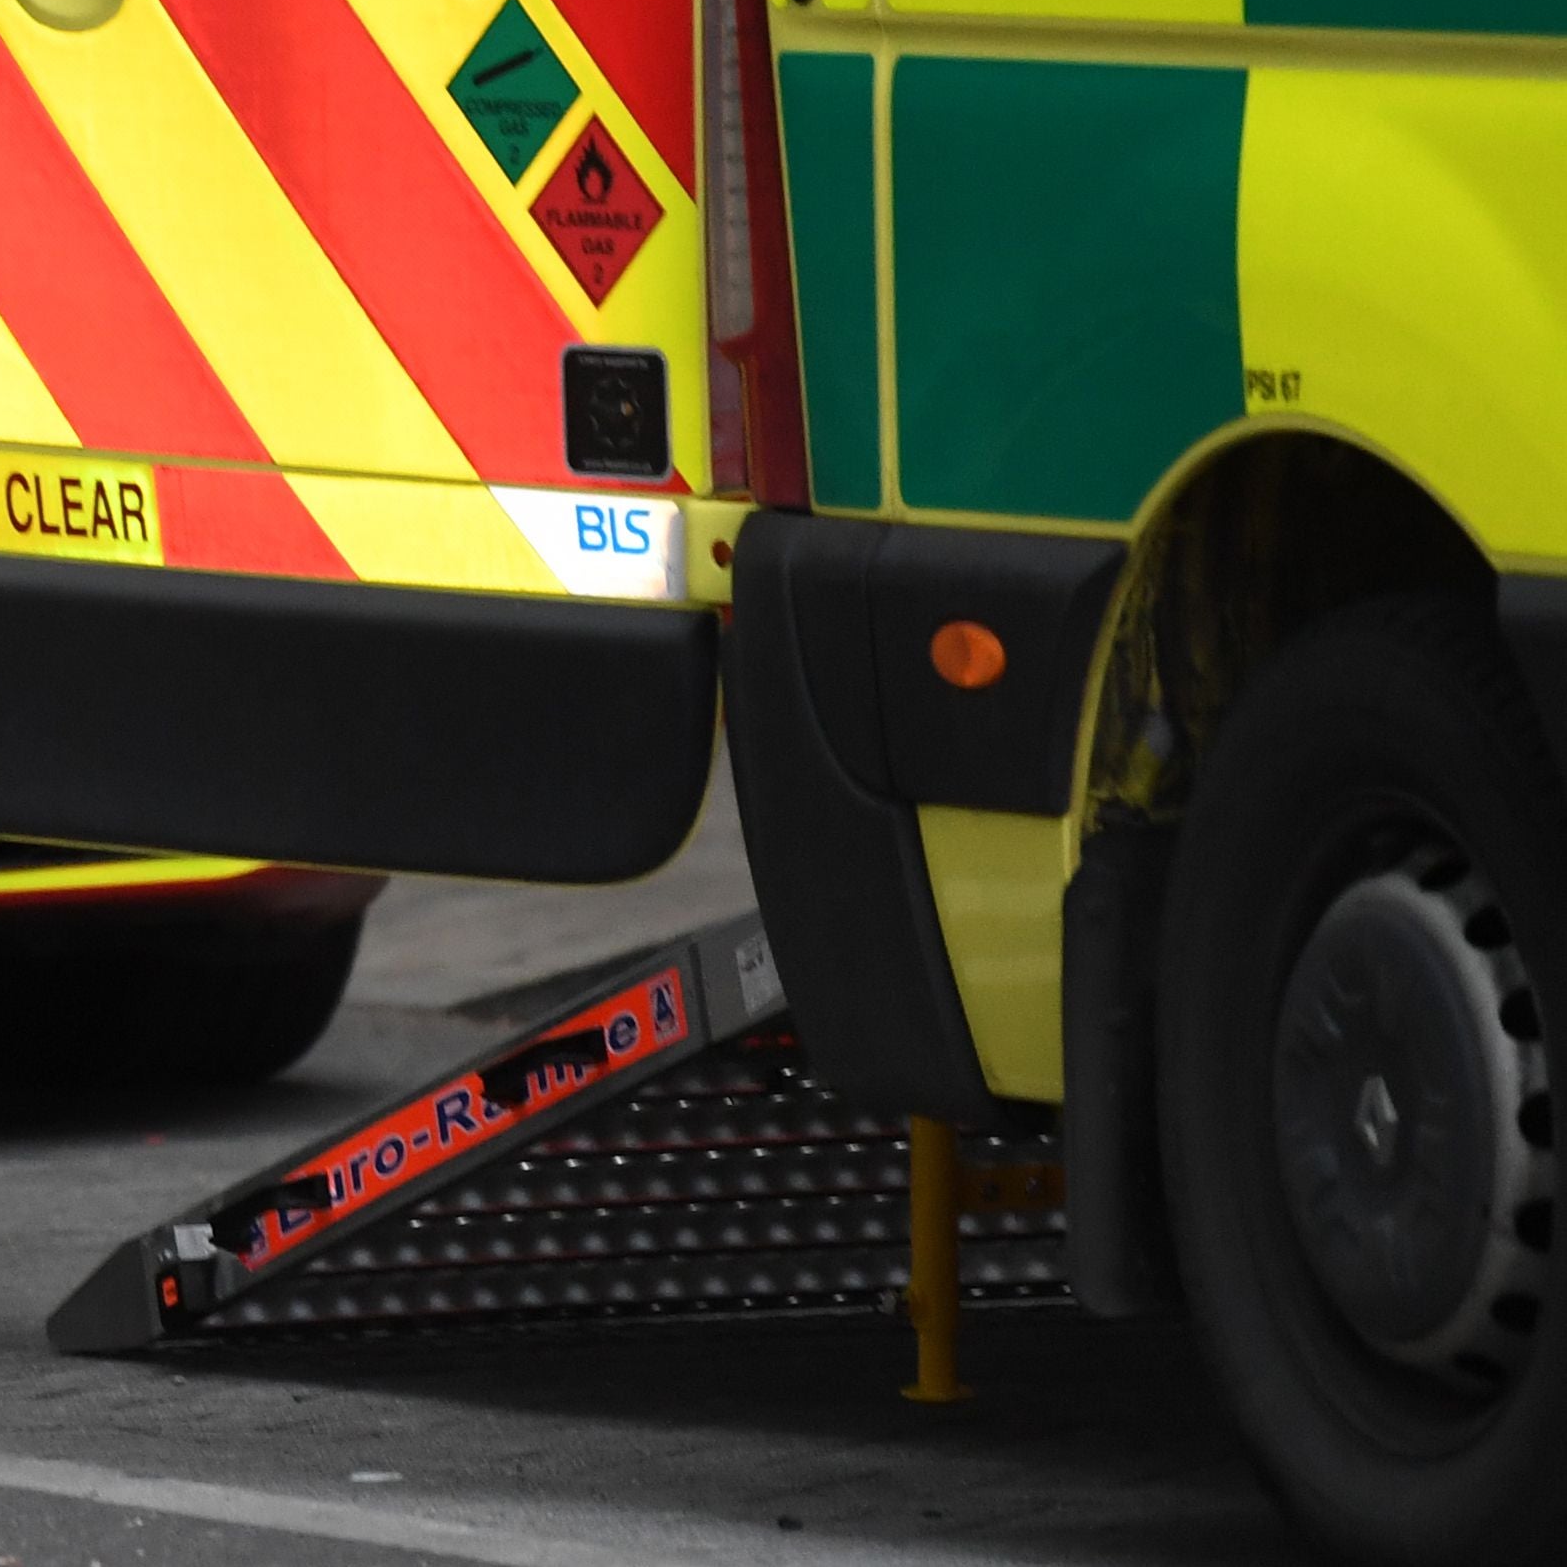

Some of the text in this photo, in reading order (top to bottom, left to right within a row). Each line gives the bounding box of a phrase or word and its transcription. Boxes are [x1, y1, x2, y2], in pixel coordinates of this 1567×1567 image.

[545, 209, 643, 230] FLAMMABLE
[5, 472, 149, 542] CLEAR
[575, 504, 651, 555] BLS
